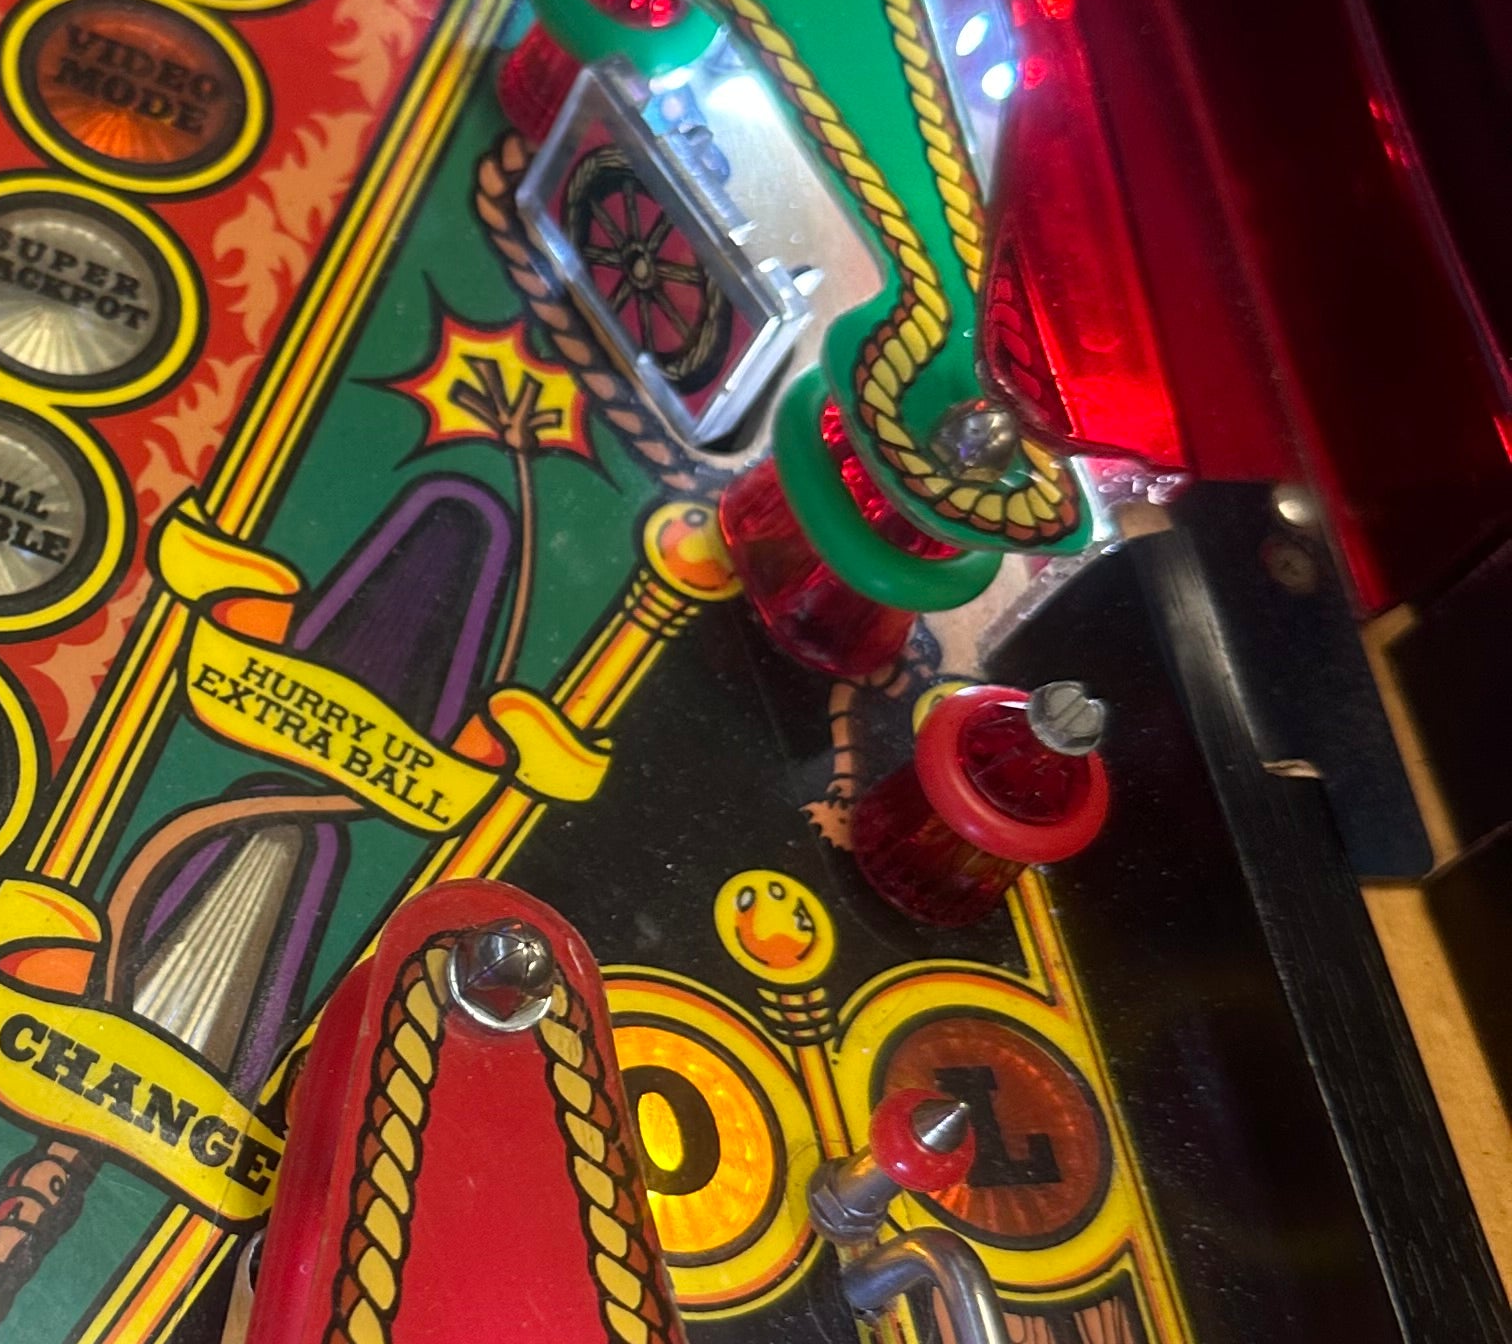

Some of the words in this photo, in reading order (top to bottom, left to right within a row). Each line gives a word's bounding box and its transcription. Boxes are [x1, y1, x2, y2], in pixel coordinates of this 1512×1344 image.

[54, 57, 208, 136] MODE
[65, 23, 221, 102] VIDEO
[191, 663, 338, 760] EXTRA
[340, 744, 451, 825] BALL
[239, 657, 378, 743] HURRY
[382, 732, 435, 772] UP
